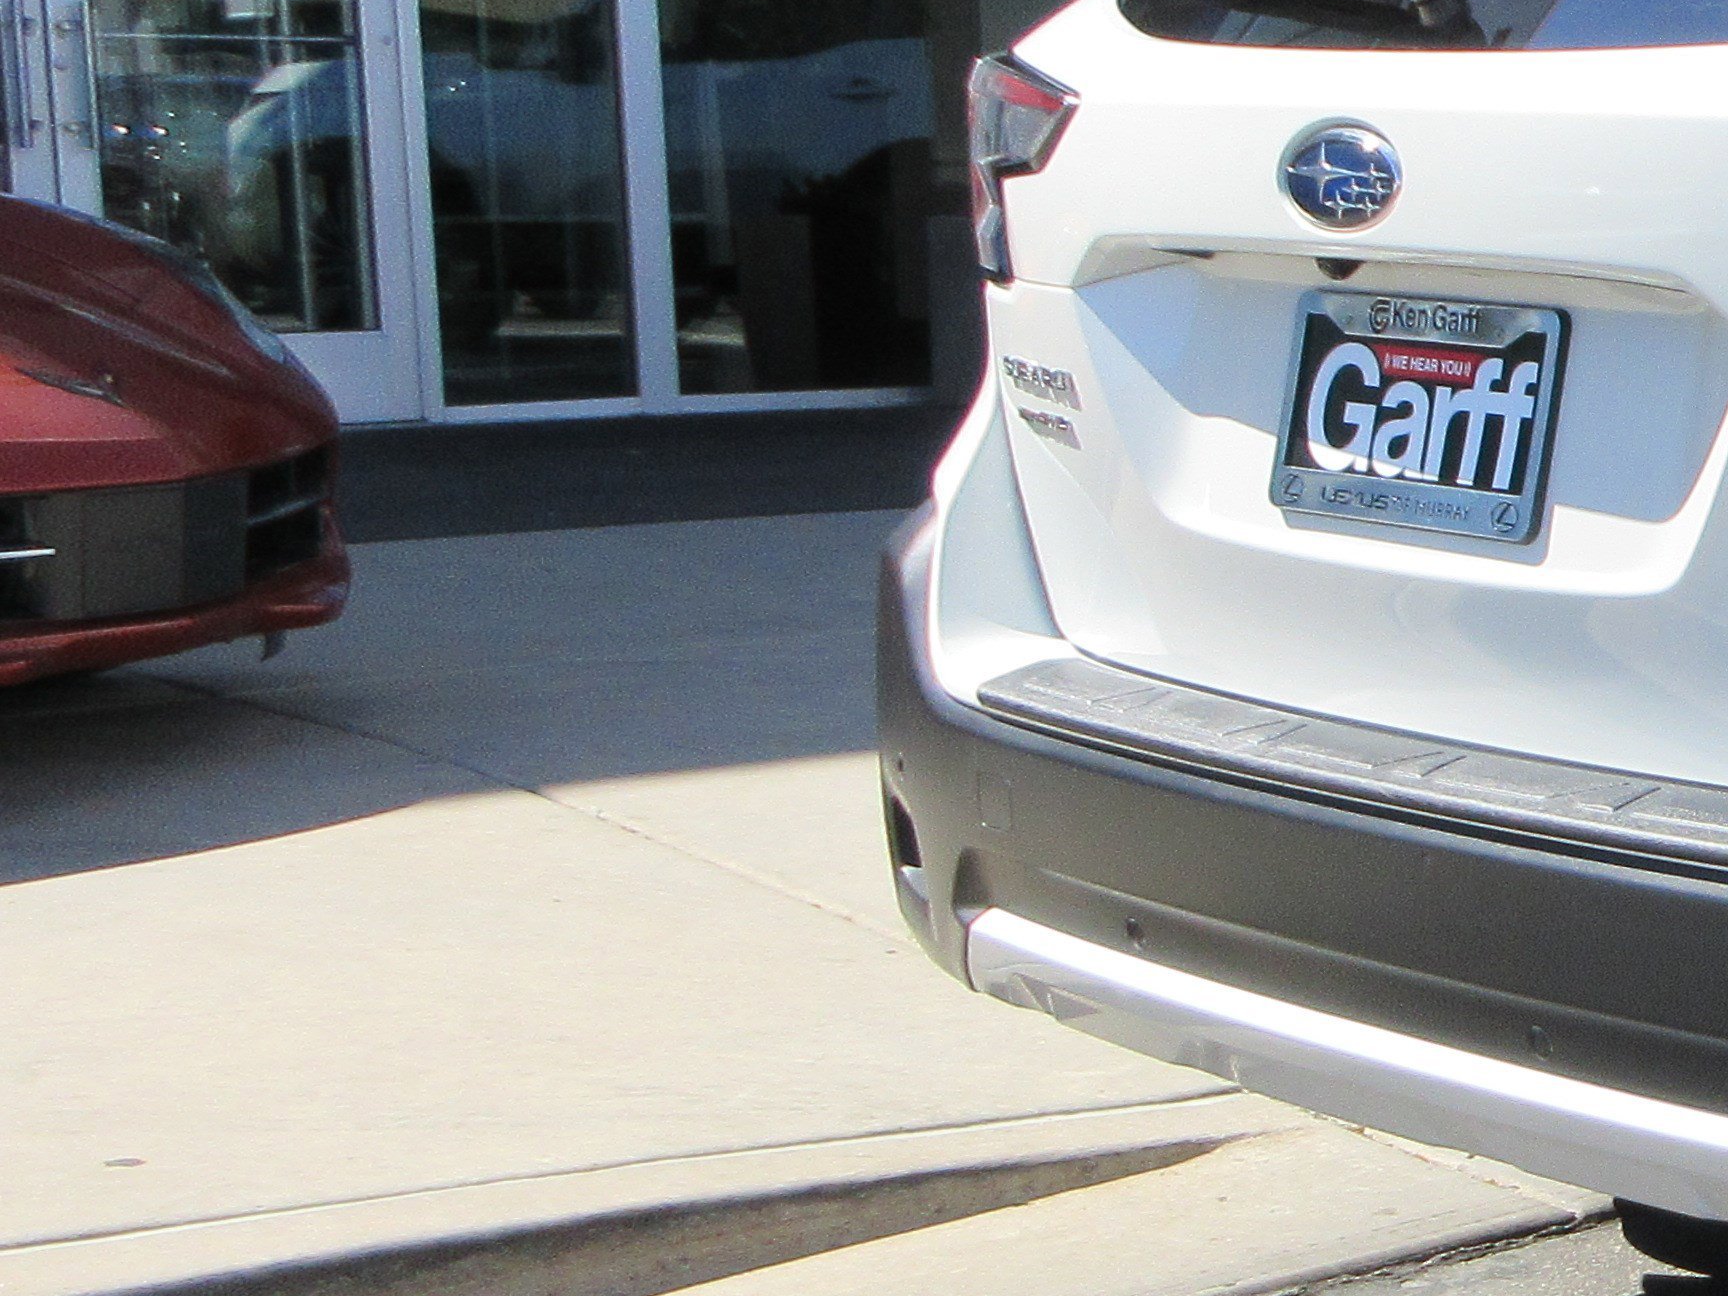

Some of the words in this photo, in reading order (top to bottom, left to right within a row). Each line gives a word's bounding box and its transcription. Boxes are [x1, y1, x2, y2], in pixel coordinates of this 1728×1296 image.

[1392, 300, 1429, 329] Ken
[1433, 302, 1482, 334] Garff
[1391, 354, 1409, 370] WE
[1410, 356, 1438, 373] HEAR
[1438, 360, 1463, 377] YOU
[1307, 342, 1539, 490] Garff
